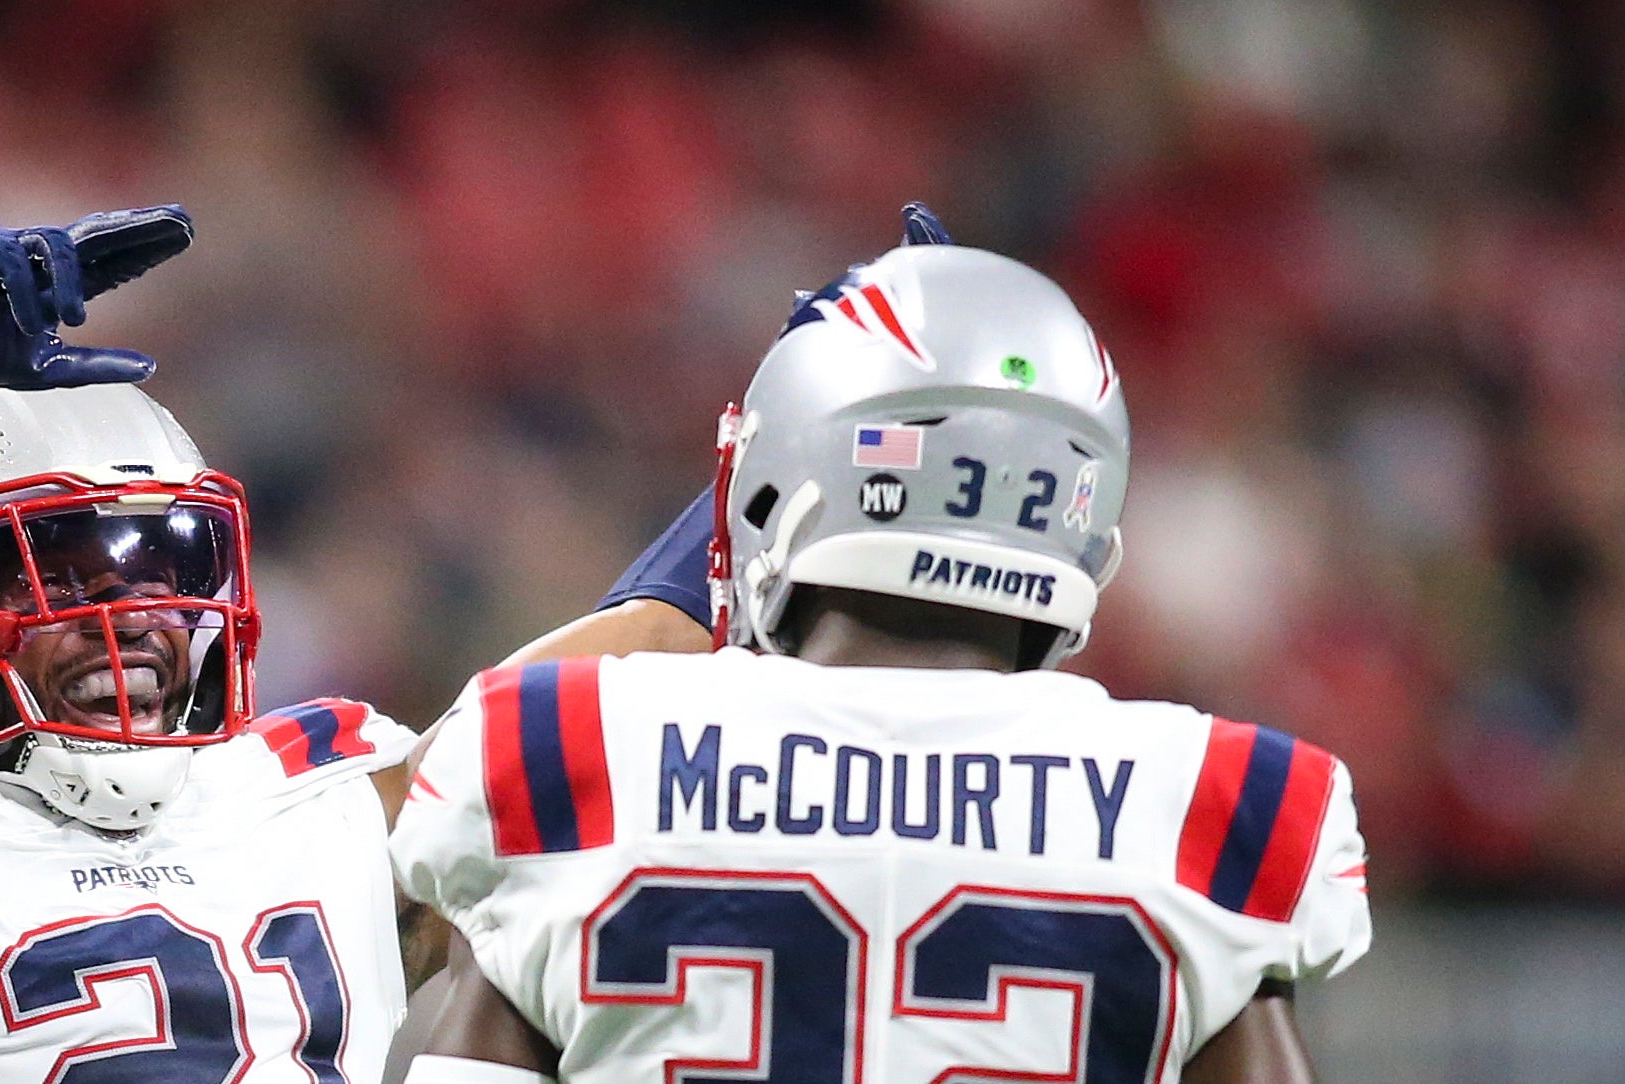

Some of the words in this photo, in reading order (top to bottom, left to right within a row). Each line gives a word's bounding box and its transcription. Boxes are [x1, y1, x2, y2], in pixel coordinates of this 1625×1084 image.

[861, 482, 904, 513] MW
[910, 549, 1056, 606] PATRIOTS
[657, 724, 1134, 860] McCOURTY
[71, 866, 195, 893] PATRIOTS
